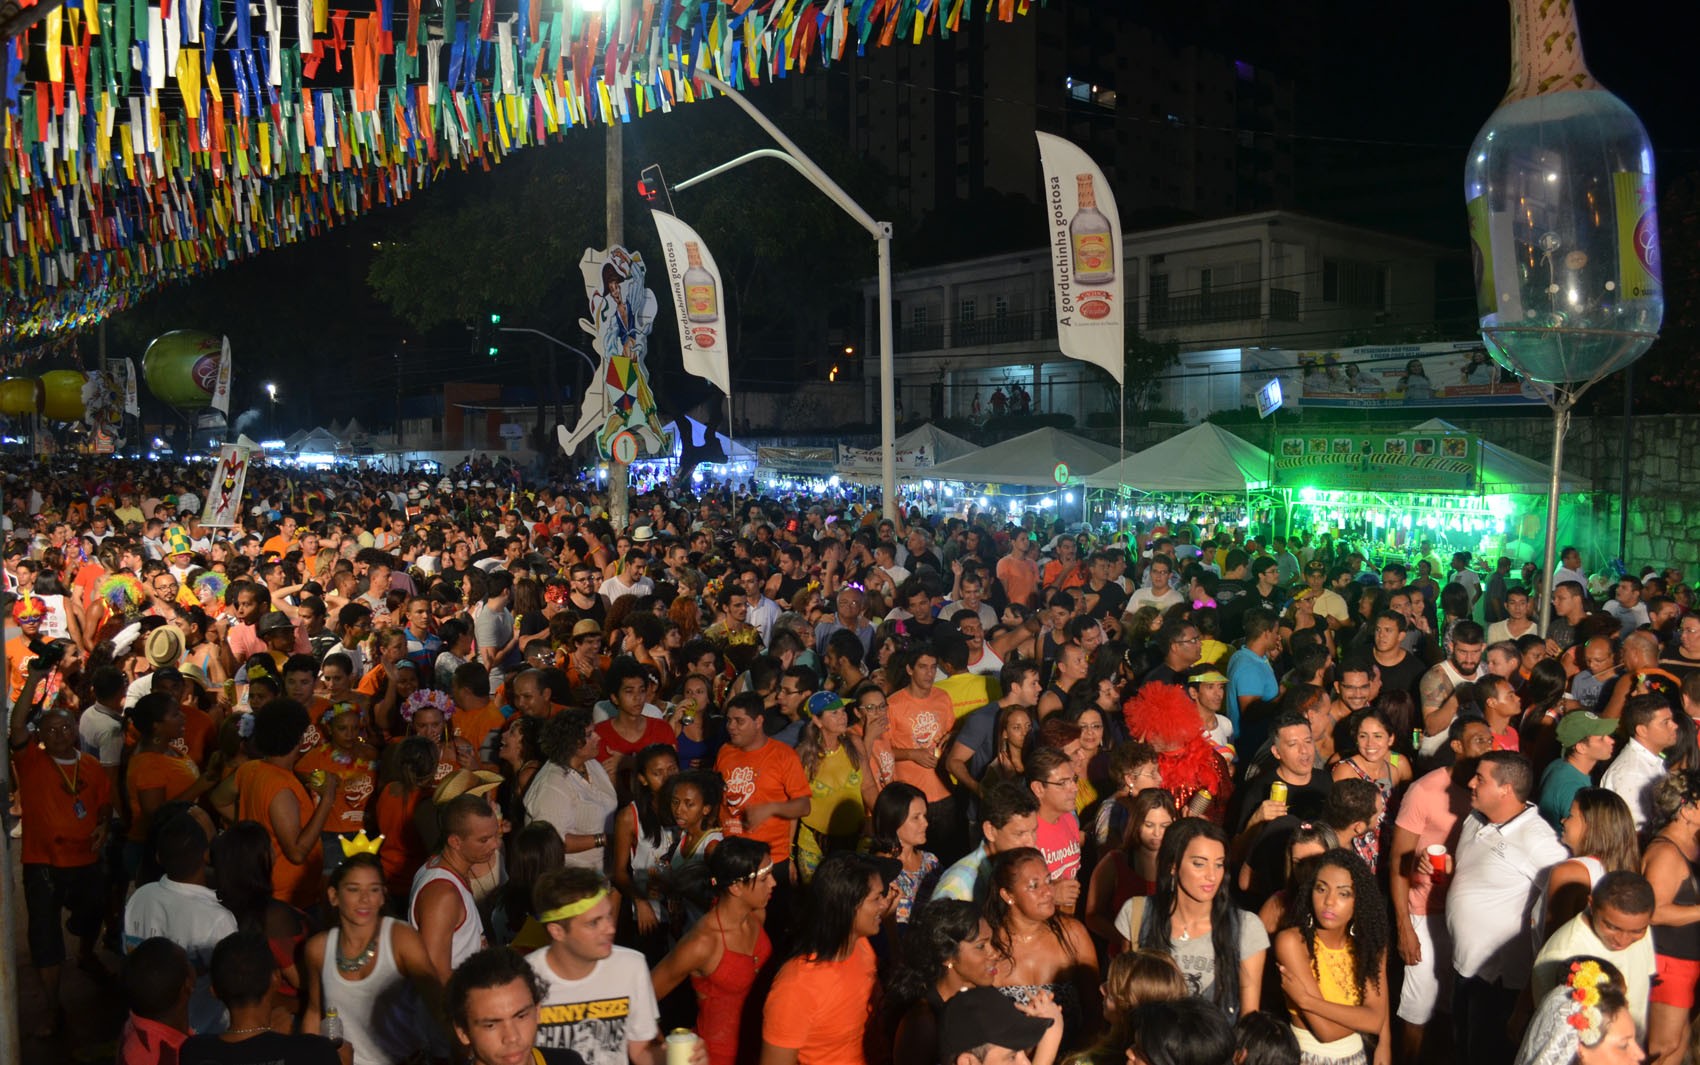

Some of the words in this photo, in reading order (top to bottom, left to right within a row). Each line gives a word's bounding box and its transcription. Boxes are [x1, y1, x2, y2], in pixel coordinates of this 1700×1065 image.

[1051, 175, 1068, 226] gostosa
[667, 242, 681, 280] gostosa
[1055, 230, 1074, 313] gorduchinha
[674, 282, 692, 341] gorduchinha
[1060, 317, 1071, 328] A
[684, 343, 693, 351] A
[1424, 457, 1473, 473] FILHO
